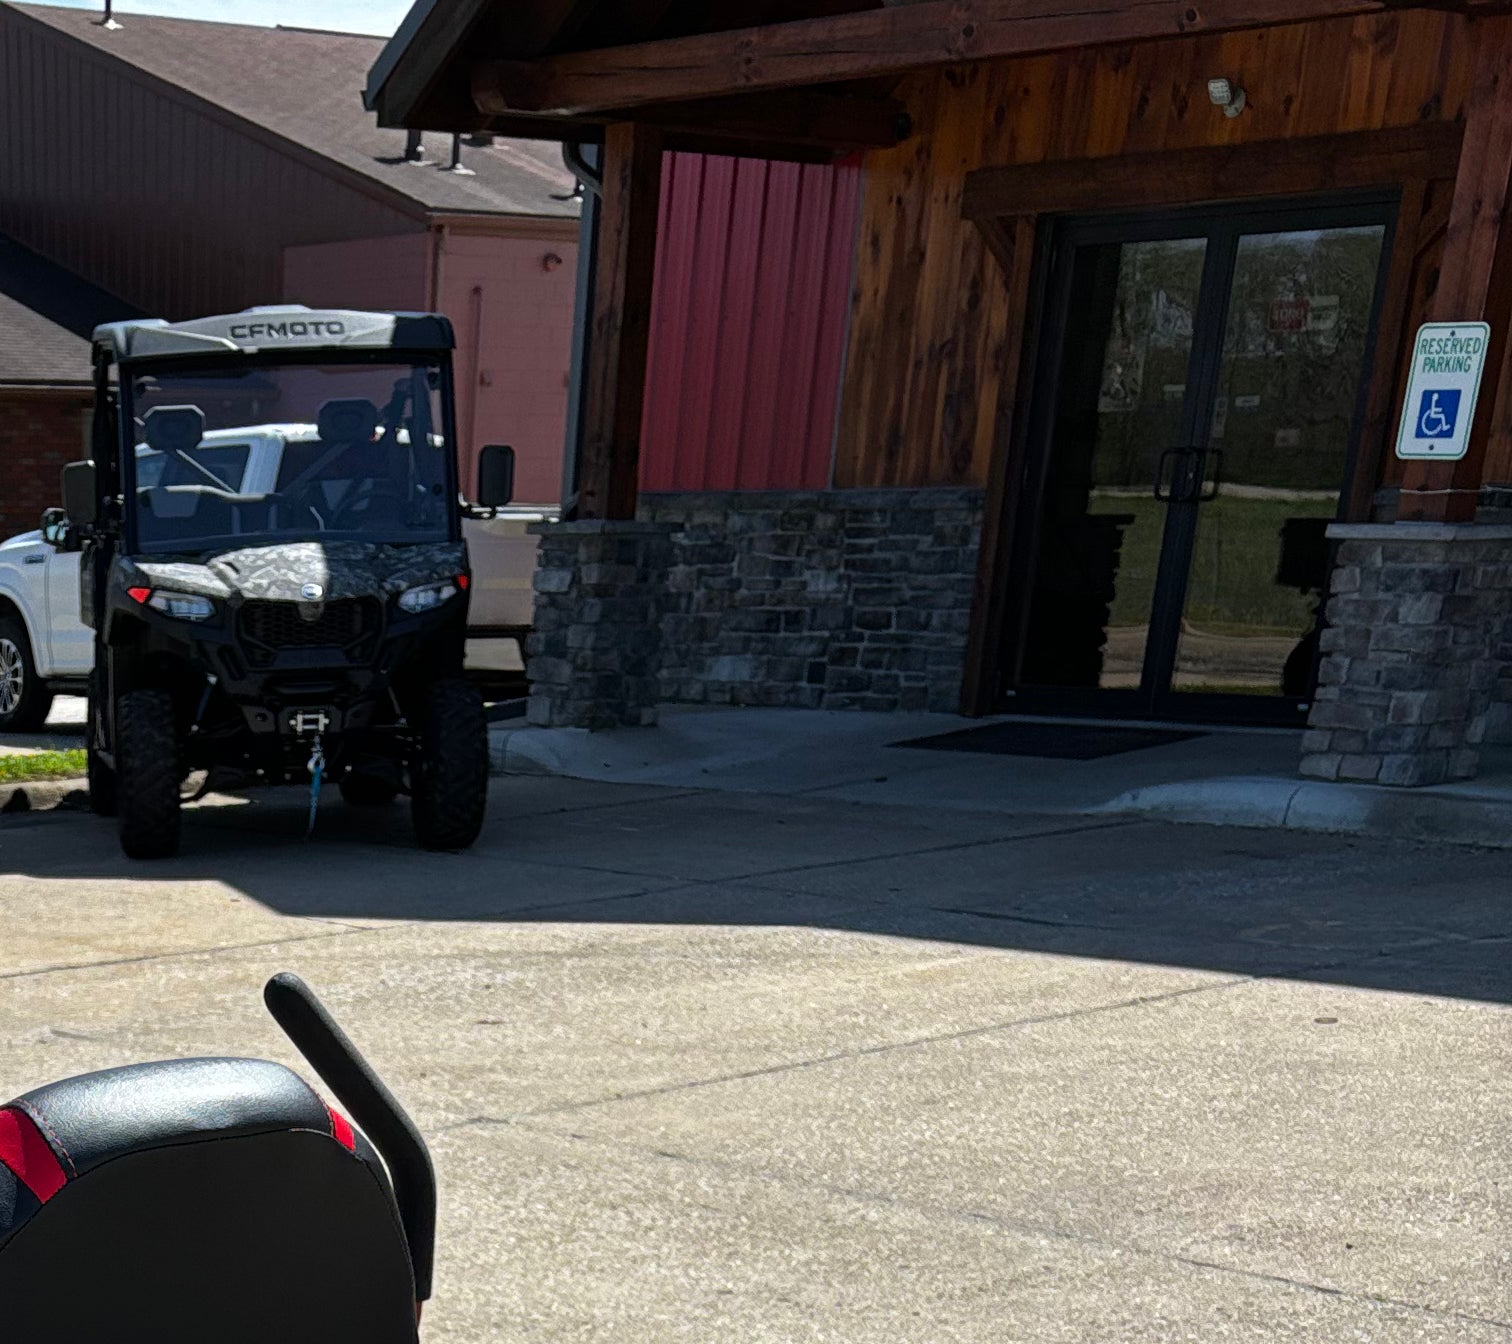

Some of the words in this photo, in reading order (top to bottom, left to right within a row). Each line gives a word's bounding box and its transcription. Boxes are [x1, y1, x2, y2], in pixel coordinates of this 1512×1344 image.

[230, 321, 345, 338] CFMOTO
[1420, 337, 1481, 355] RESERVED
[1422, 356, 1473, 373] PARKING
